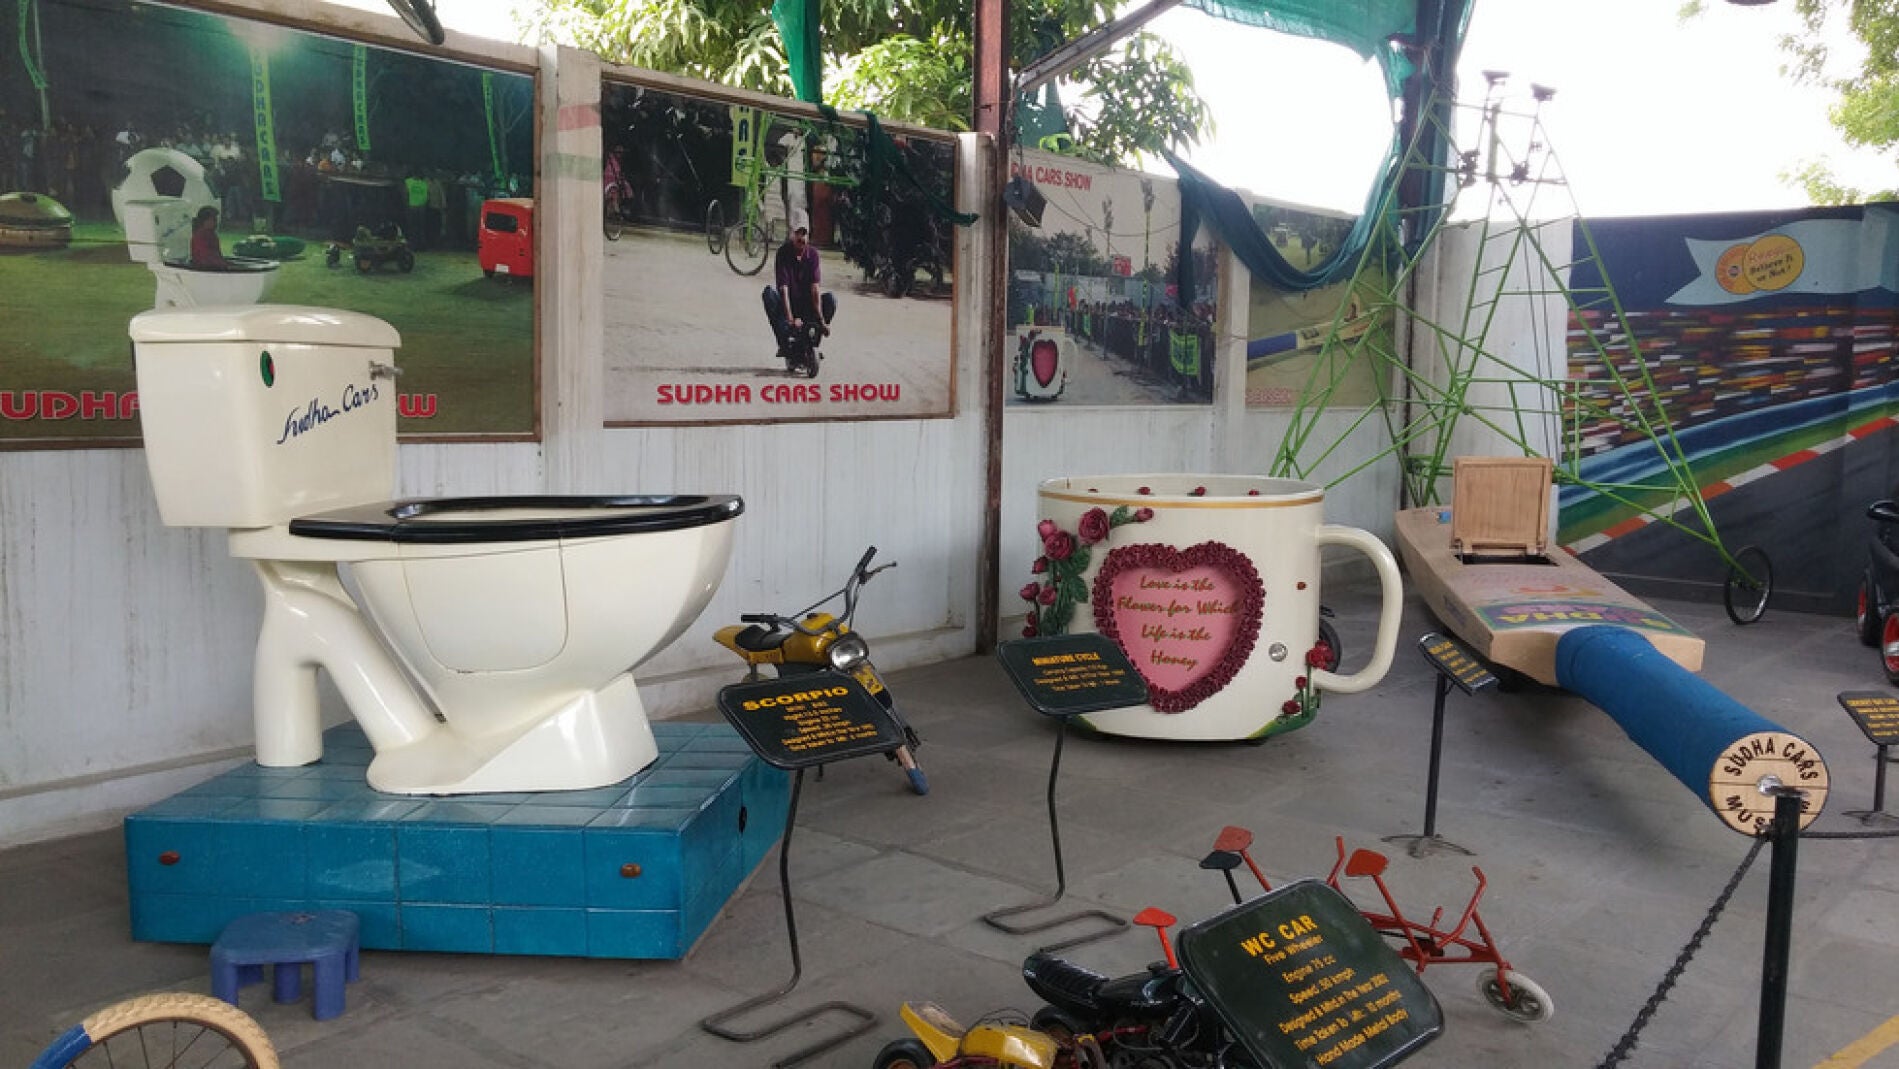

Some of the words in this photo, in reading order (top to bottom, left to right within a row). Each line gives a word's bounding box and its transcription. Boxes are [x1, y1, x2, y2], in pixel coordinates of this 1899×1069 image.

[1035, 166, 1063, 186] CARS
[1064, 170, 1092, 191] SHOW
[0, 391, 139, 420] UDHA
[342, 384, 379, 412] Cars
[656, 383, 752, 404] SUDHA
[760, 383, 822, 403] CARS
[829, 383, 900, 401] SHOW
[1140, 575, 1169, 590] Love
[1191, 577, 1215, 592] the
[1117, 596, 1164, 613] Flower
[1167, 599, 1191, 617] for
[1141, 624, 1166, 642] Life
[1189, 627, 1211, 641] the
[1151, 649, 1198, 671] Honey
[742, 686, 848, 711] SCORPIO
[1724, 737, 1775, 777] SUDHA
[1783, 742, 1819, 780] CARS
[1241, 932, 1276, 957] WC
[1278, 914, 1319, 940] CAR
[1263, 951, 1287, 965] Five
[1285, 934, 1324, 955] Wheeler
[1282, 965, 1314, 984] Engine
[1278, 1009, 1318, 1034] Designed
[1315, 1045, 1343, 1066] Hand
[1338, 1033, 1366, 1052] Made
[1362, 1018, 1390, 1038] Metal
[1385, 1008, 1408, 1025] Body
